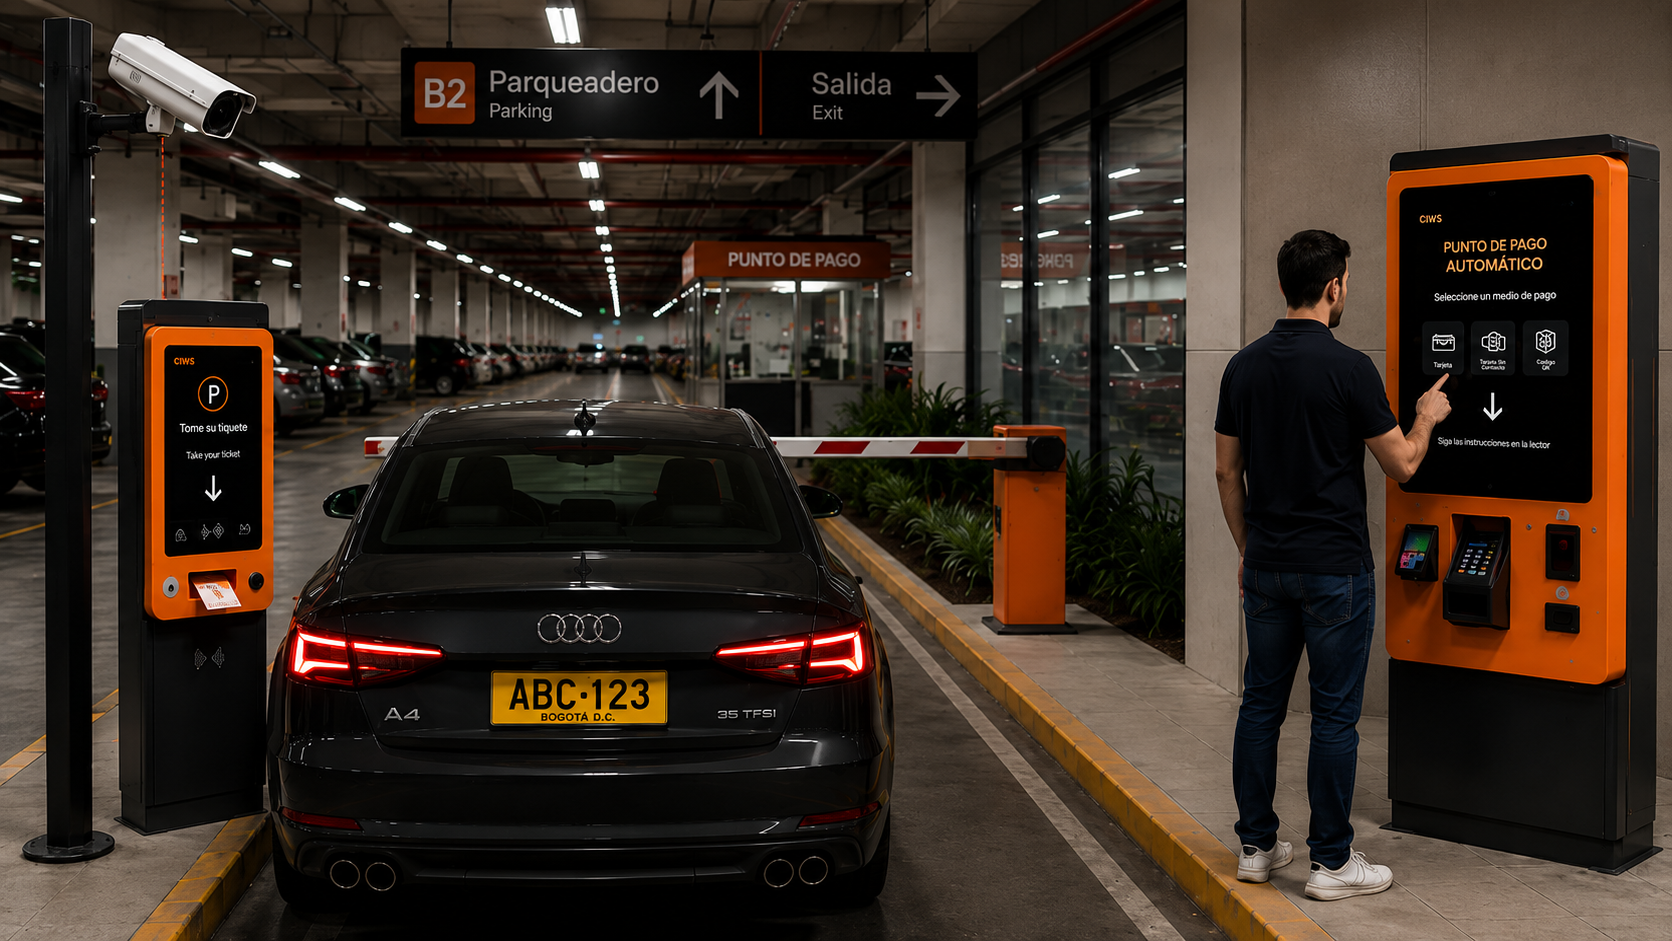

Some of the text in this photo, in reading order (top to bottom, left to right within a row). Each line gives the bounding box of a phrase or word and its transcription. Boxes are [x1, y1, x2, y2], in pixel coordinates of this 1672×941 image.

[490, 70, 659, 99] Parqueadero
[812, 71, 892, 96] Salida
[424, 78, 467, 109] B2
[490, 103, 553, 122] Parking
[813, 105, 844, 121] Exit
[1419, 214, 1443, 224] CIWS
[1443, 237, 1548, 254] PUNTO DE PAGO
[728, 252, 861, 267] PUNTO DE PAGO
[1445, 255, 1544, 273] AUTOMÁTICO
[1434, 290, 1557, 302] Seleccione un medio de pago
[174, 357, 195, 366] CIWS
[1433, 361, 1453, 370] Tarjeta
[208, 384, 220, 404] P
[179, 422, 248, 435] Tome su tiquete
[1437, 436, 1453, 447] Siga
[1453, 437, 1464, 446] las
[1464, 438, 1510, 448] instrucciones
[1529, 440, 1551, 449] lector
[186, 449, 241, 462] Take your ticket
[384, 707, 421, 721] A4
[540, 710, 616, 722] BOGOTÁ D.C.
[717, 709, 777, 719] 35 TFSI
